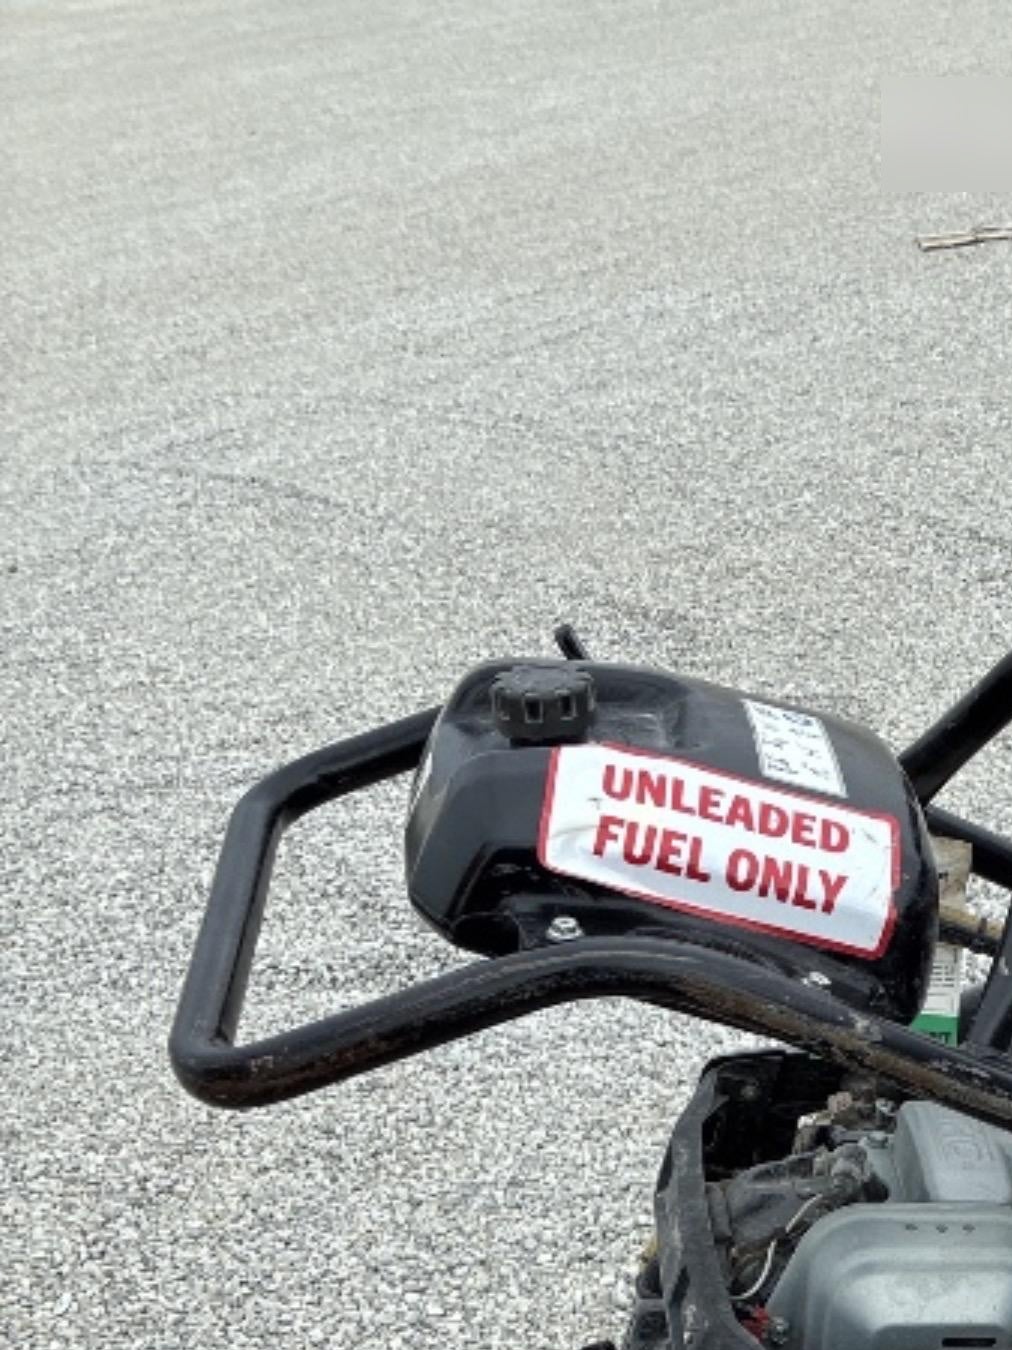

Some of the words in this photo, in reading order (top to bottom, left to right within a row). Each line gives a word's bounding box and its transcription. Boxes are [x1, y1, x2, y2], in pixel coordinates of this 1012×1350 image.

[601, 763, 850, 854] UNLEADED
[592, 815, 710, 884] FUEL
[727, 848, 850, 915] ONLY
